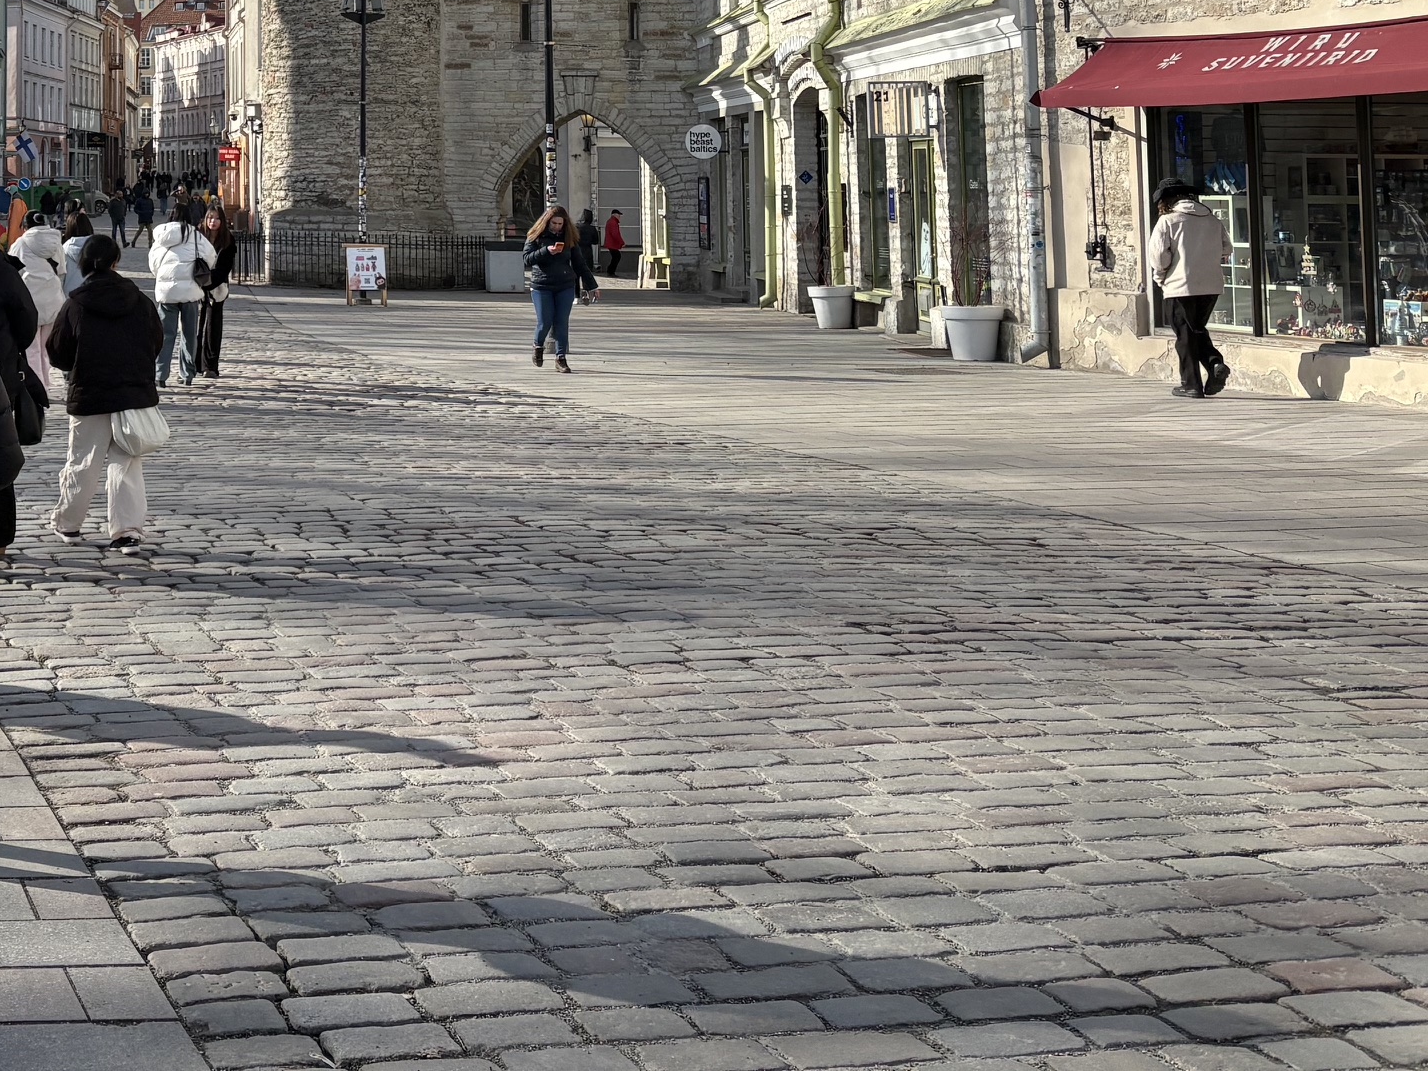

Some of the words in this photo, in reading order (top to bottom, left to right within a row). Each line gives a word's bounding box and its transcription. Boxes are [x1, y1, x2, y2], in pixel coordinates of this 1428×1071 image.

[1260, 32, 1361, 52] WIRU
[1202, 49, 1379, 72] SUVENIIRID
[689, 131, 711, 139] hype
